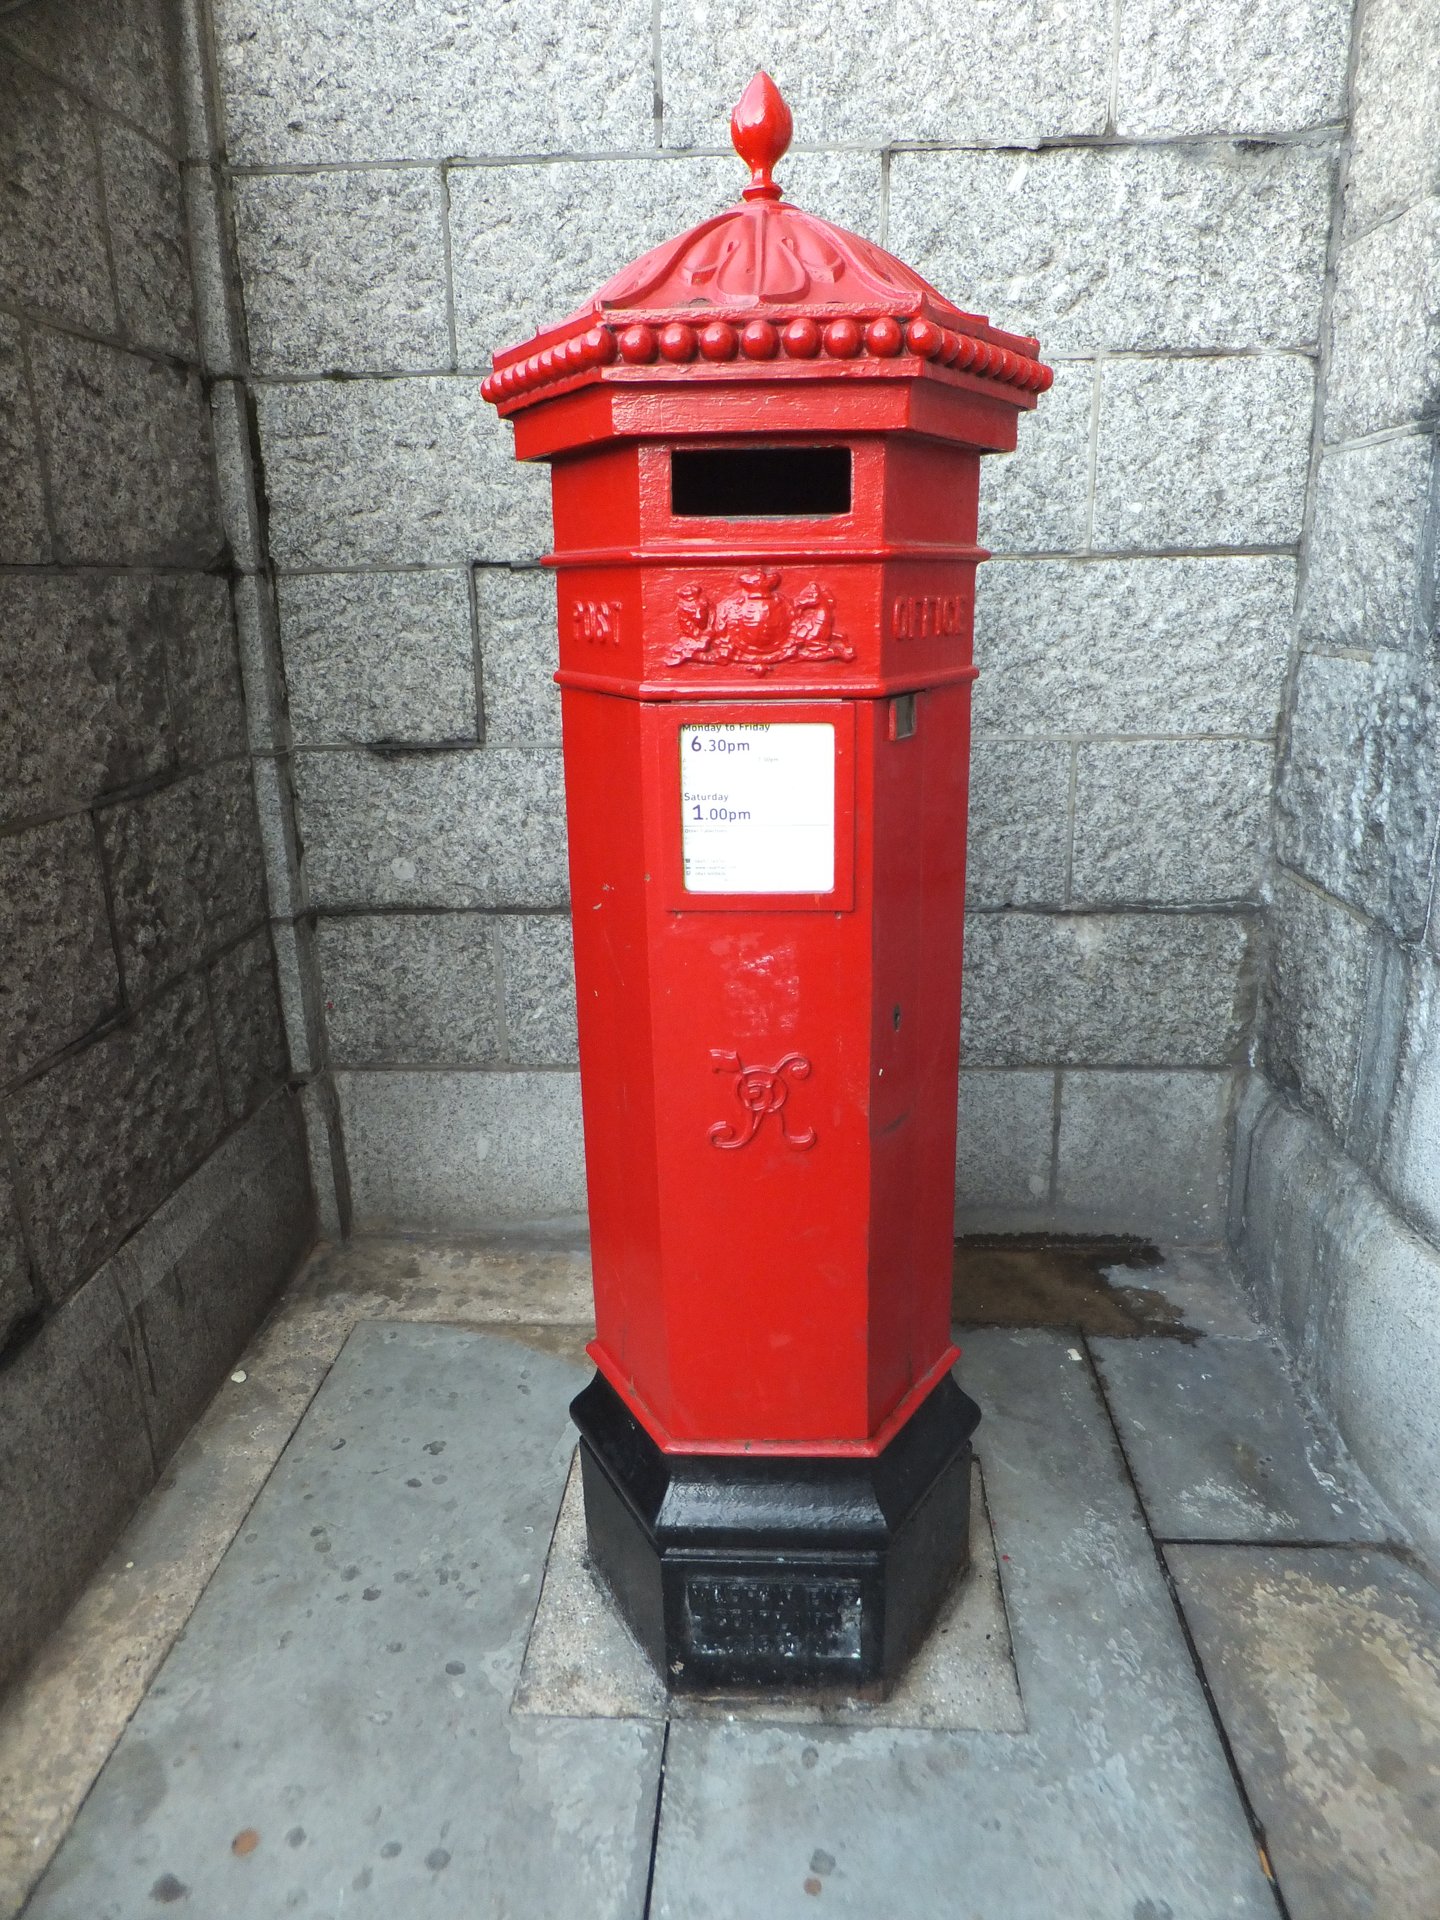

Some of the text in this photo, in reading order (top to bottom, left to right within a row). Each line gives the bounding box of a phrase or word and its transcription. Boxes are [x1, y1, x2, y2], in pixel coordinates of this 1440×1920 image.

[573, 600, 622, 642] POST
[891, 594, 967, 640] OFFICE
[682, 723, 771, 733] Monday to Friday
[691, 735, 750, 754] 6.30pm
[684, 792, 729, 802] Saturday
[692, 804, 751, 822] 1.00pm
